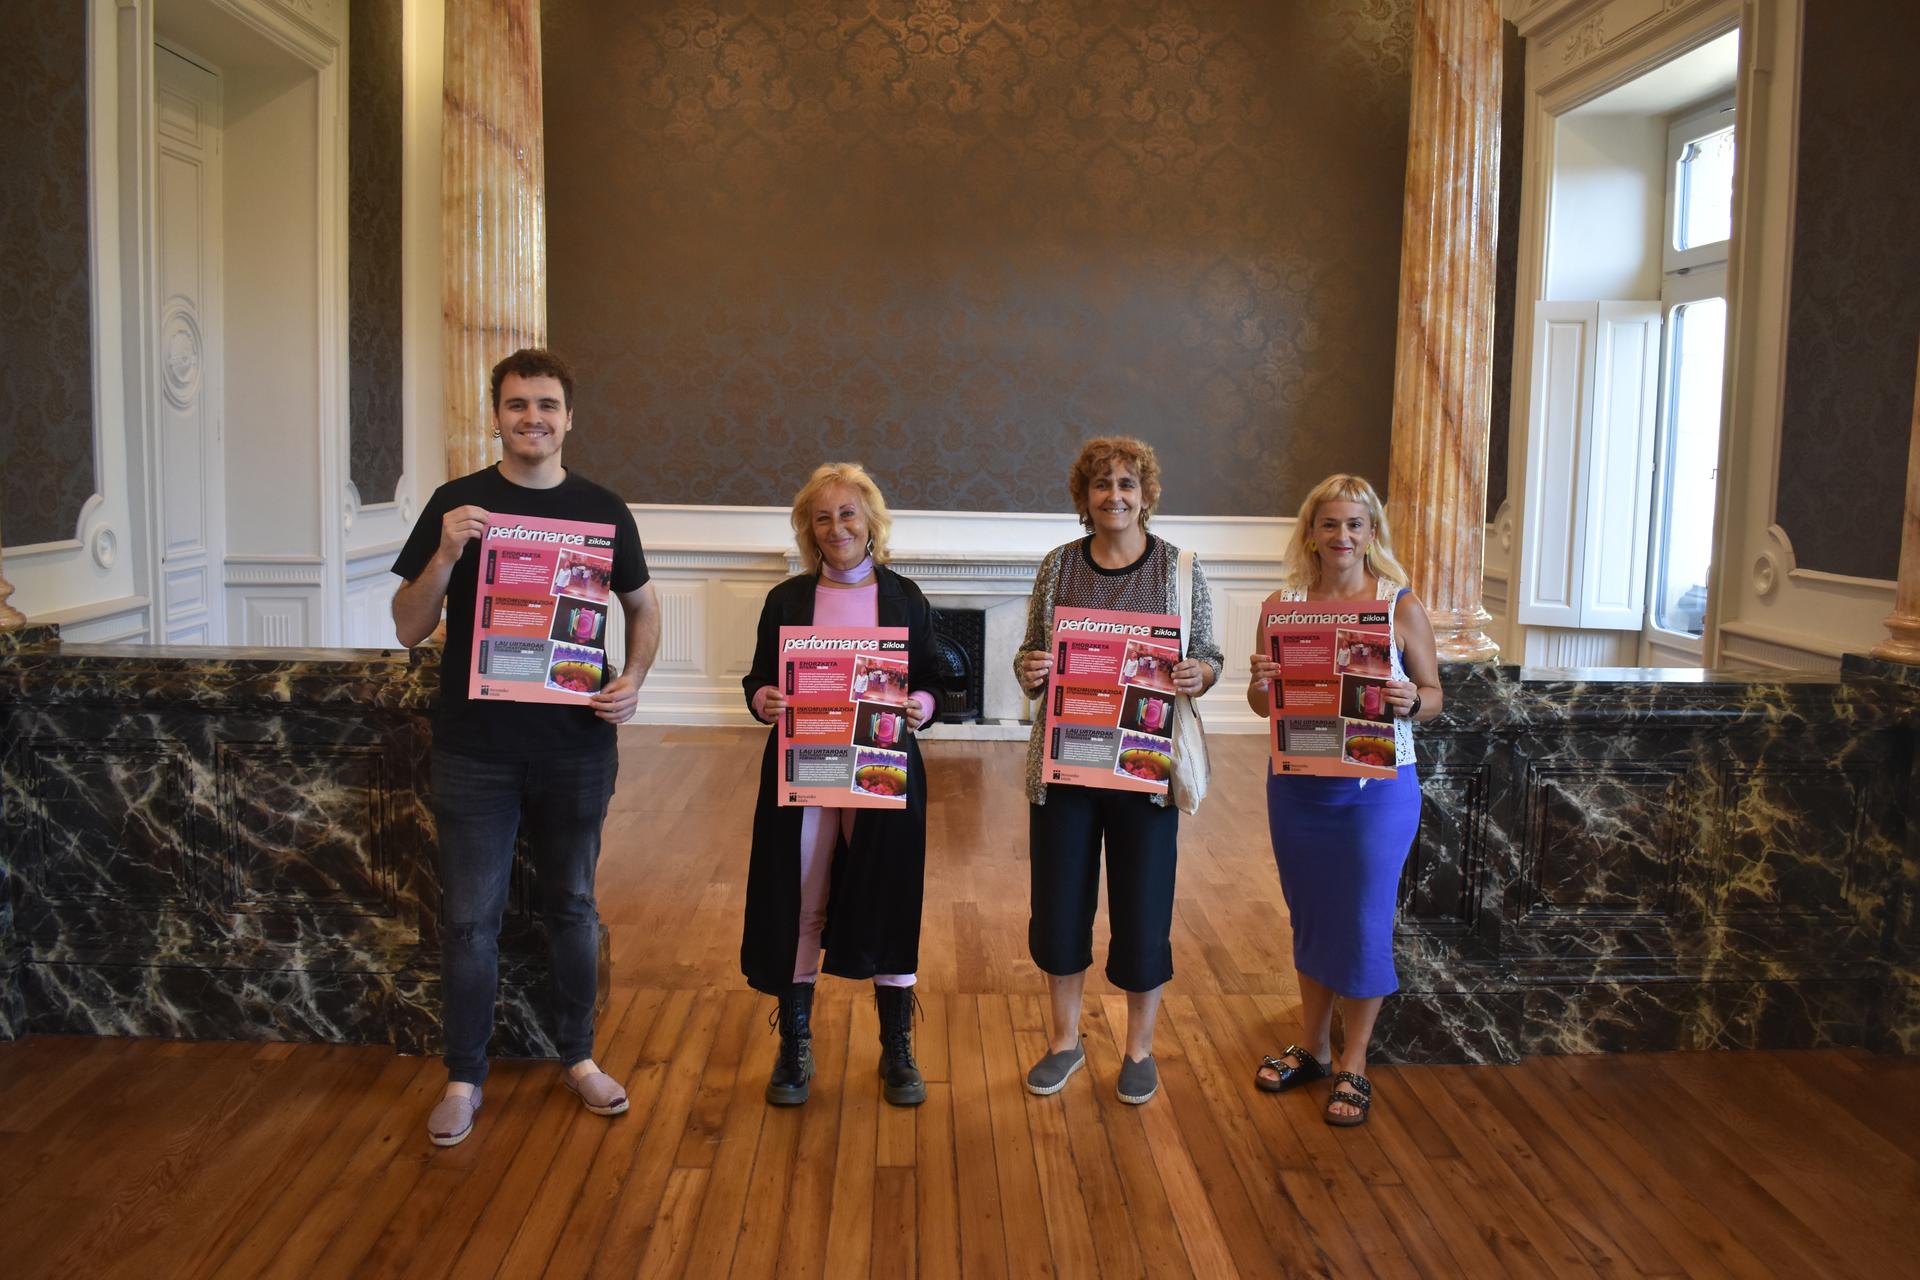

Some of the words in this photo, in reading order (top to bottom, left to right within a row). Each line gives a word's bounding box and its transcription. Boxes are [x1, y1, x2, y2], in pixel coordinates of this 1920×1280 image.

[487, 524, 585, 546] performance
[587, 537, 611, 547] zikloa
[1057, 616, 1151, 637] performance
[1153, 629, 1178, 638] zikloa
[1266, 610, 1359, 628] performance
[1362, 614, 1386, 623] zikloa
[783, 634, 879, 653] performance
[882, 641, 905, 650] zikloa
